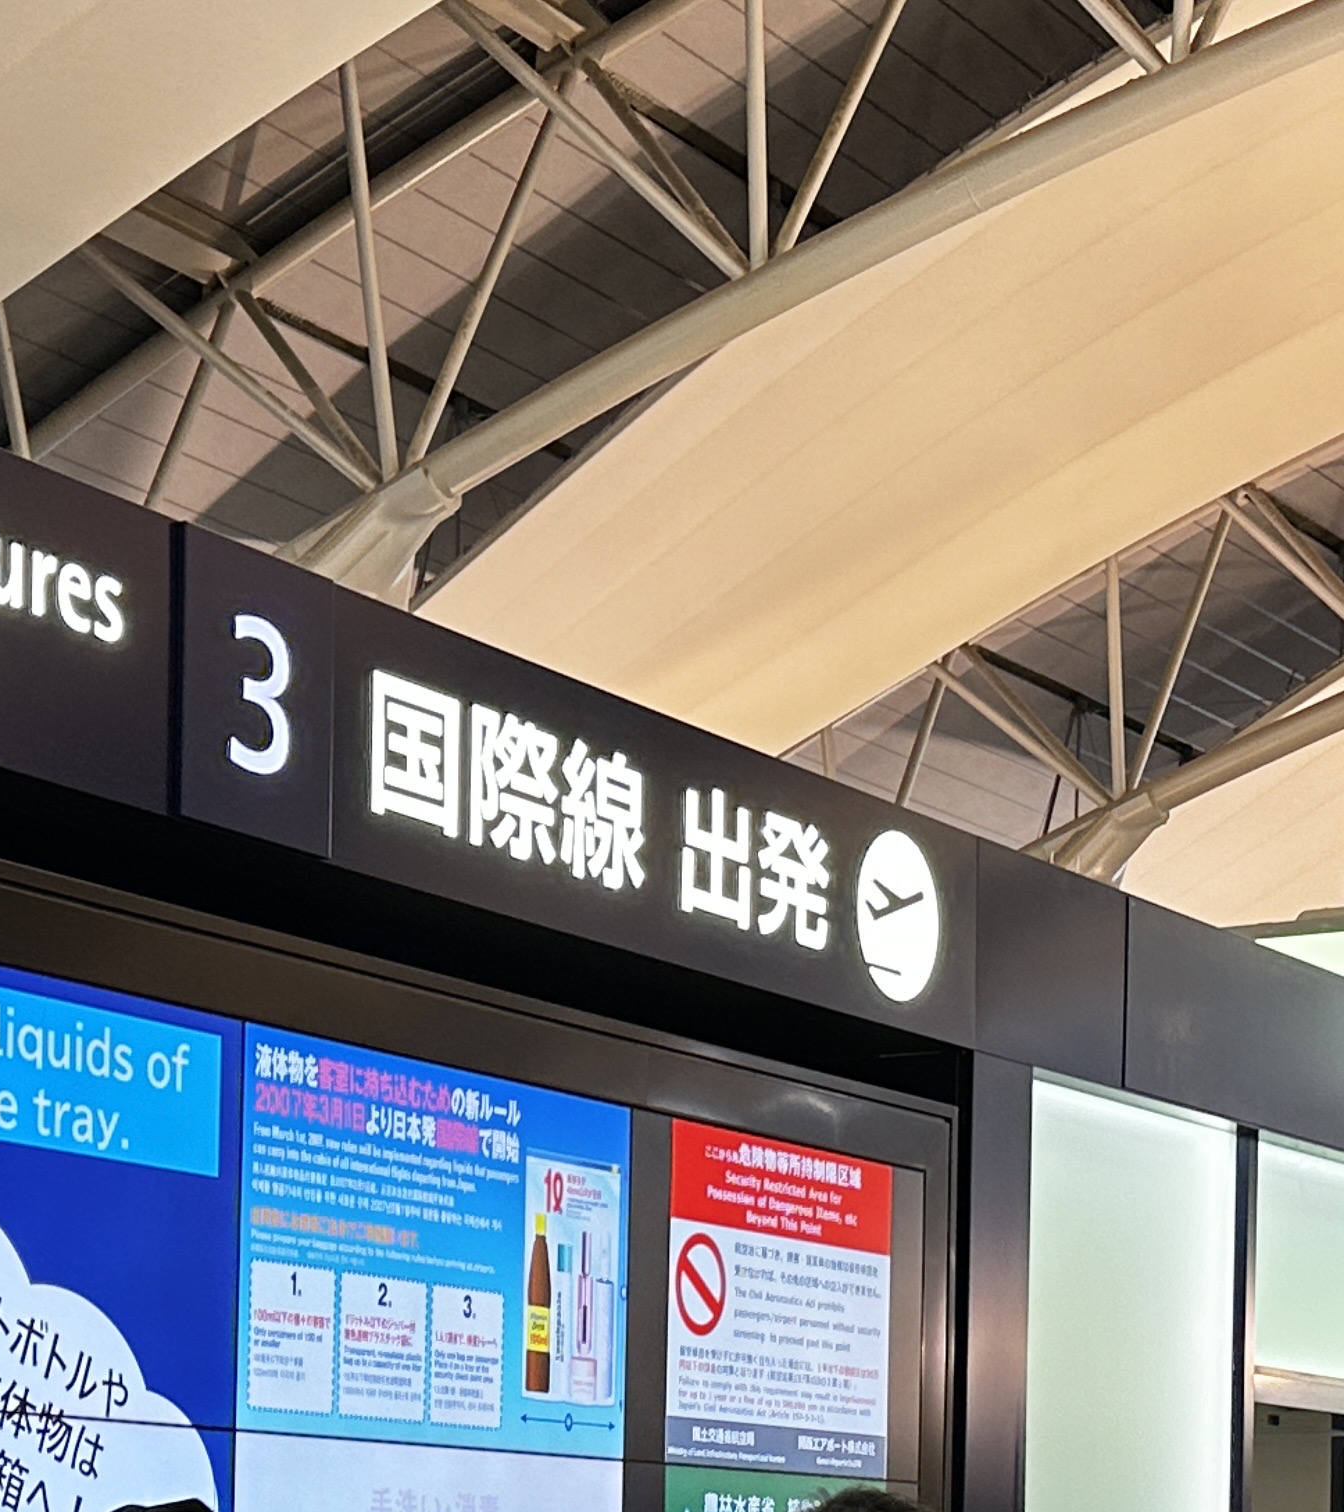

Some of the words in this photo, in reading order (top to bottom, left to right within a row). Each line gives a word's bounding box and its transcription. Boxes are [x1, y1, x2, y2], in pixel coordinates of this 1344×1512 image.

[228, 613, 290, 775] 3
[370, 668, 645, 891] 国際線
[680, 789, 830, 952] 出発
[146, 1044, 189, 1091] of
[33, 1090, 130, 1151] tray.
[706, 1183, 755, 1207] Possession
[756, 1193, 766, 1209] of
[768, 1196, 813, 1221] Dangerous
[724, 1168, 761, 1192] Security
[763, 1176, 806, 1199] Restricted
[808, 1185, 828, 1204] Area
[829, 1190, 842, 1207] for
[745, 1209, 778, 1230] Beyond
[779, 1215, 798, 1232] This
[799, 1219, 822, 1237] Point
[290, 1270, 302, 1297] 1.
[377, 1281, 392, 1308] 2.
[462, 1293, 477, 1320] 3.
